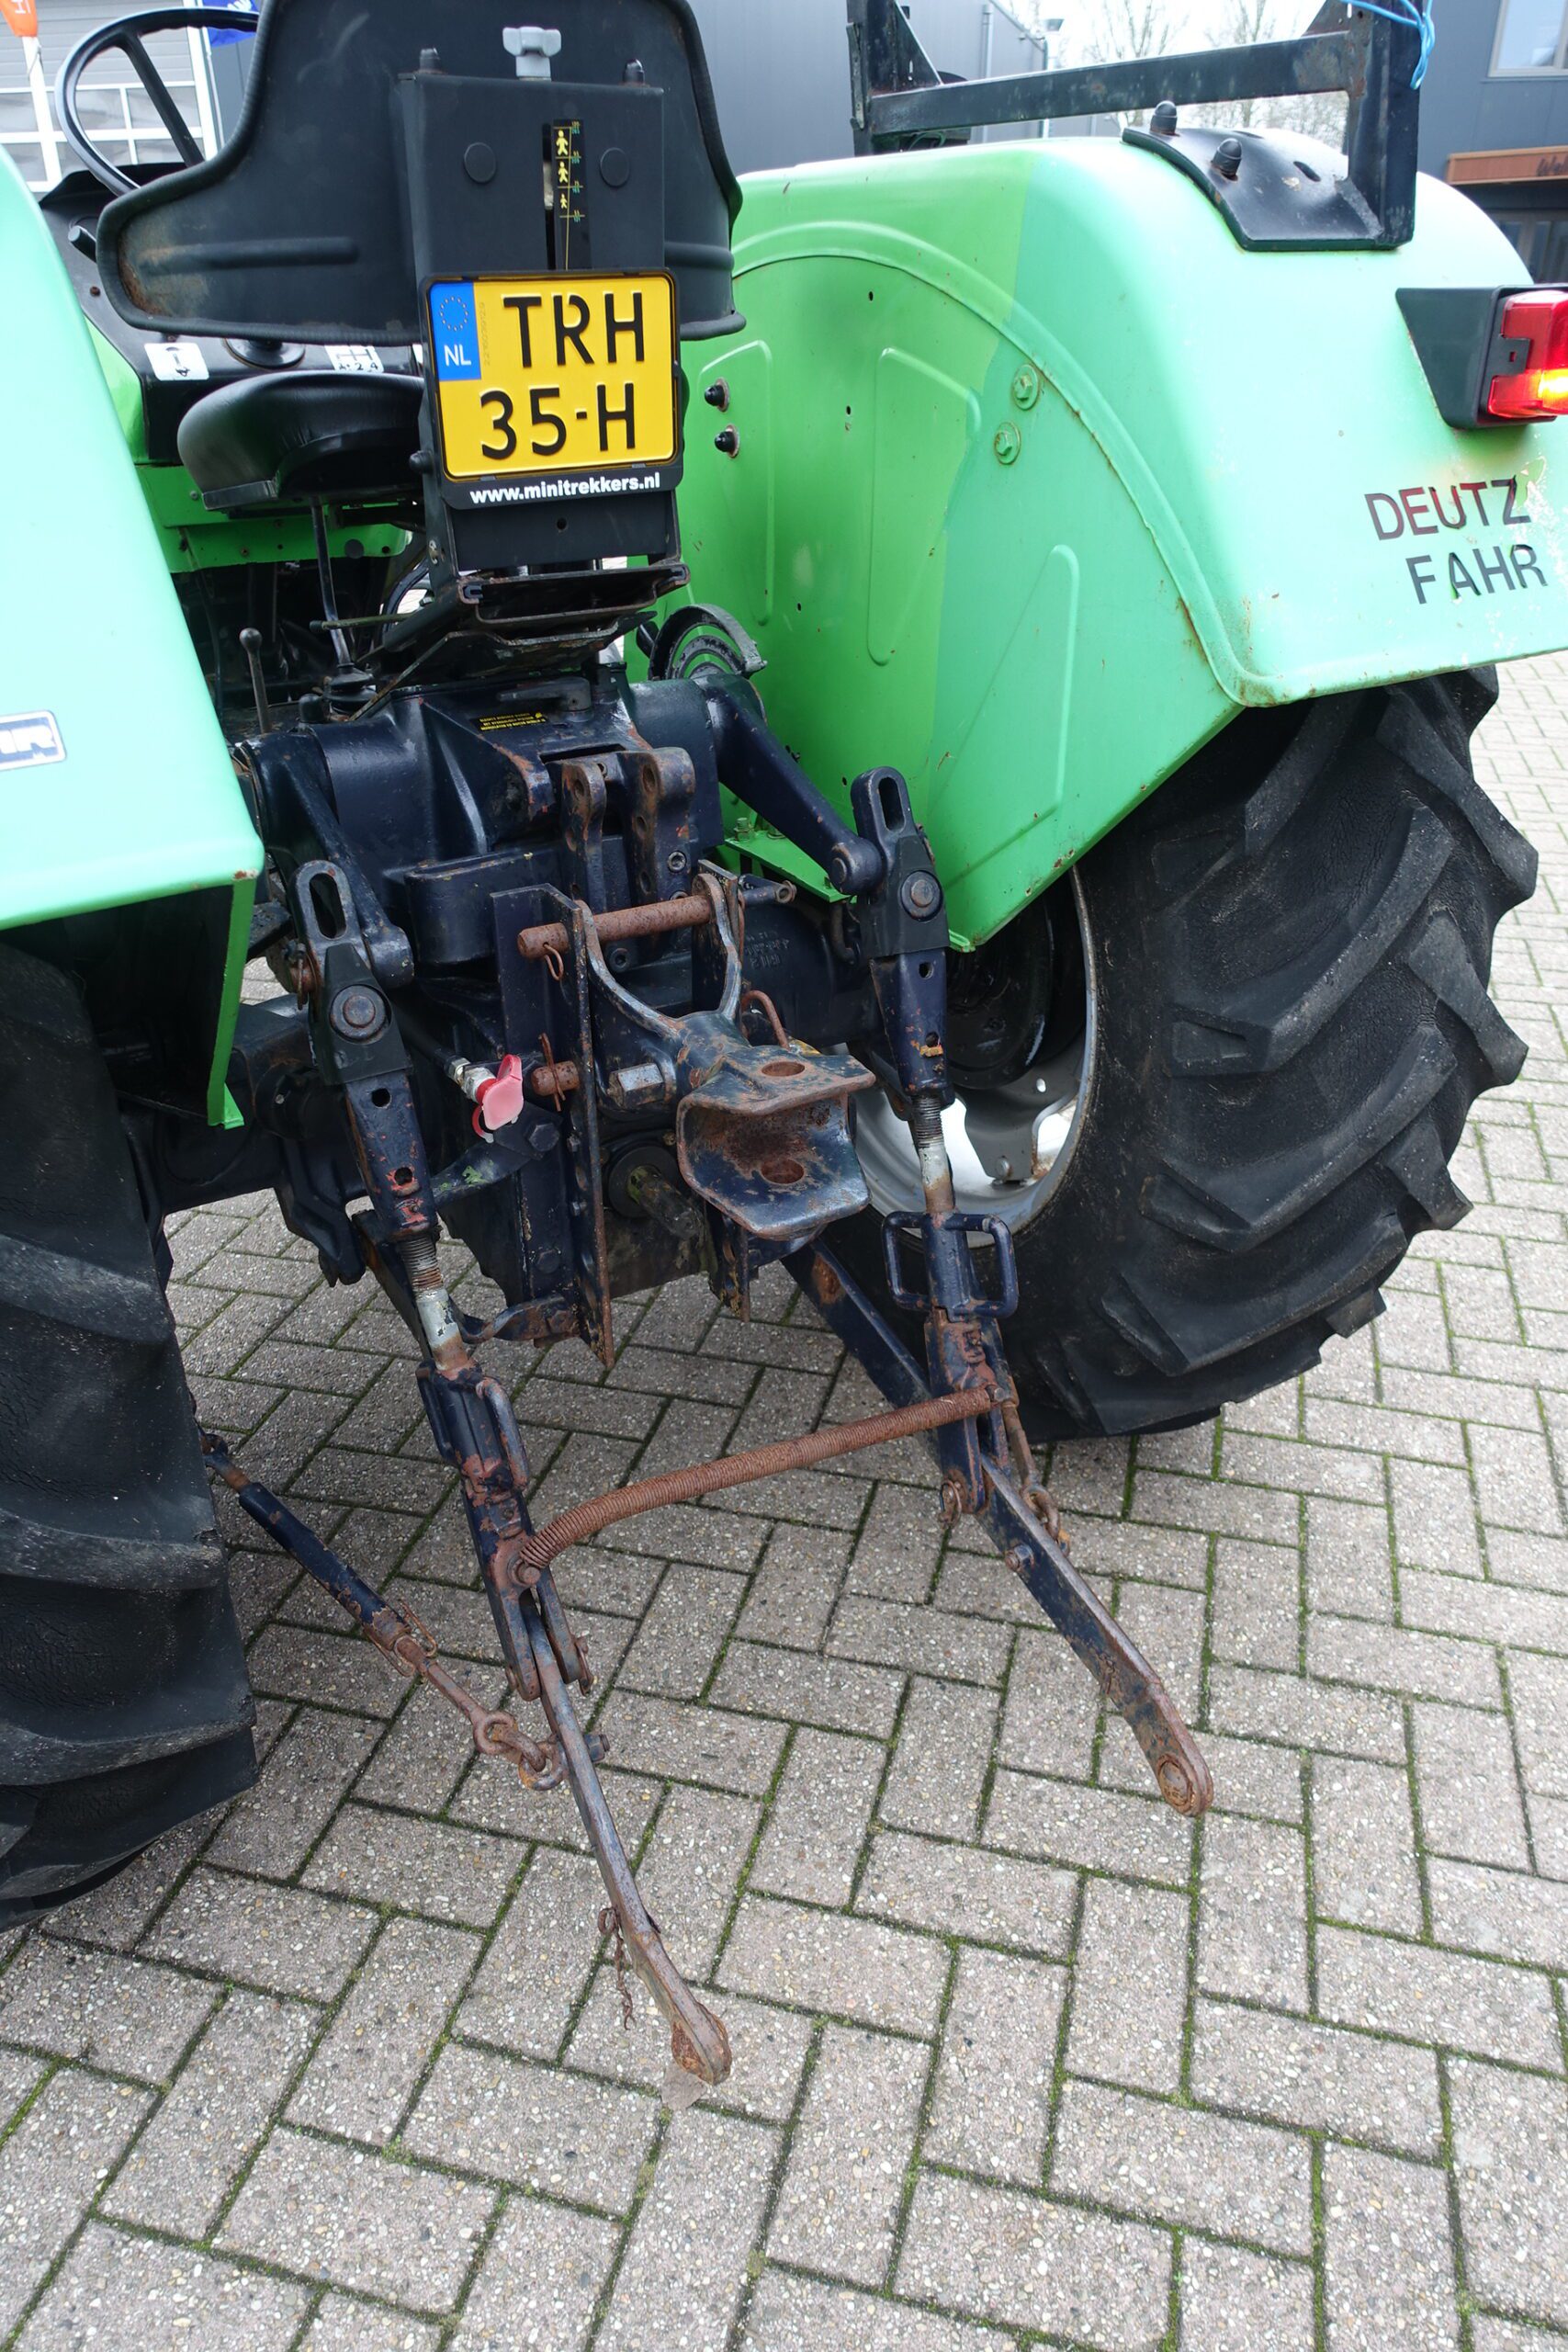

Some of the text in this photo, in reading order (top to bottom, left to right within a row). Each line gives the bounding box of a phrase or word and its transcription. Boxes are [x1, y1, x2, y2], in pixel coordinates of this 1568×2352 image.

[444, 344, 472, 367] NL
[502, 291, 645, 368] TRH
[479, 382, 636, 460] 35-H
[469, 471, 660, 504] www.minitrekkers.nl
[1364, 475, 1531, 540] DEUTZ
[1405, 544, 1548, 605] FAHR
